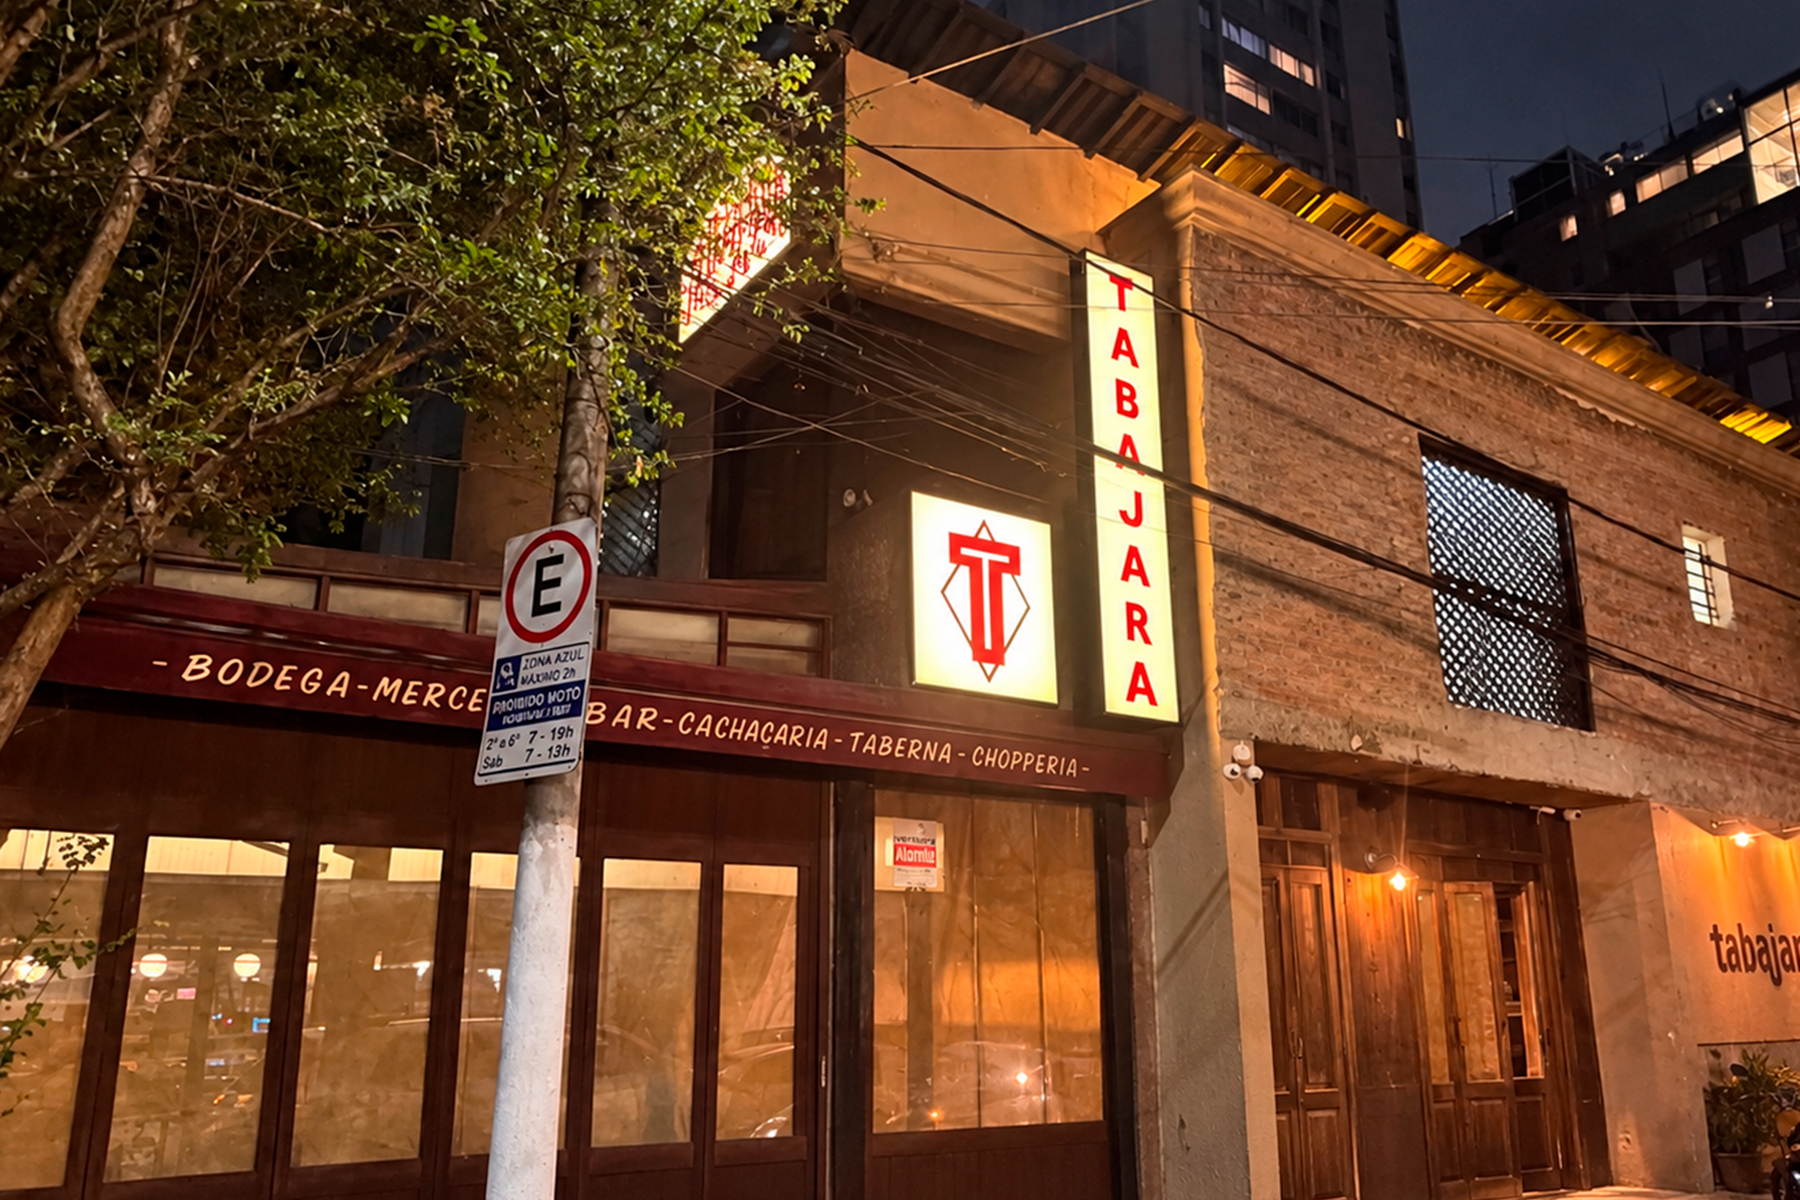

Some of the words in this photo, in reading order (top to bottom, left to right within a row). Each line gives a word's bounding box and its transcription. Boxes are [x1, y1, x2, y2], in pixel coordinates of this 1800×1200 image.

[1109, 274, 1159, 707] TABAJARA
[531, 554, 564, 617] E
[522, 654, 552, 671] ZONA
[554, 649, 584, 664] AZUL
[547, 686, 581, 704] MOTO
[181, 654, 350, 698] BODEGA
[585, 702, 658, 731] BAR
[850, 731, 951, 764] TABERNA
[971, 746, 1078, 778] CHOPPERIA
[529, 730, 538, 744] 7
[550, 725, 574, 740] 19h
[525, 748, 534, 762] 7
[547, 743, 571, 759] 13h
